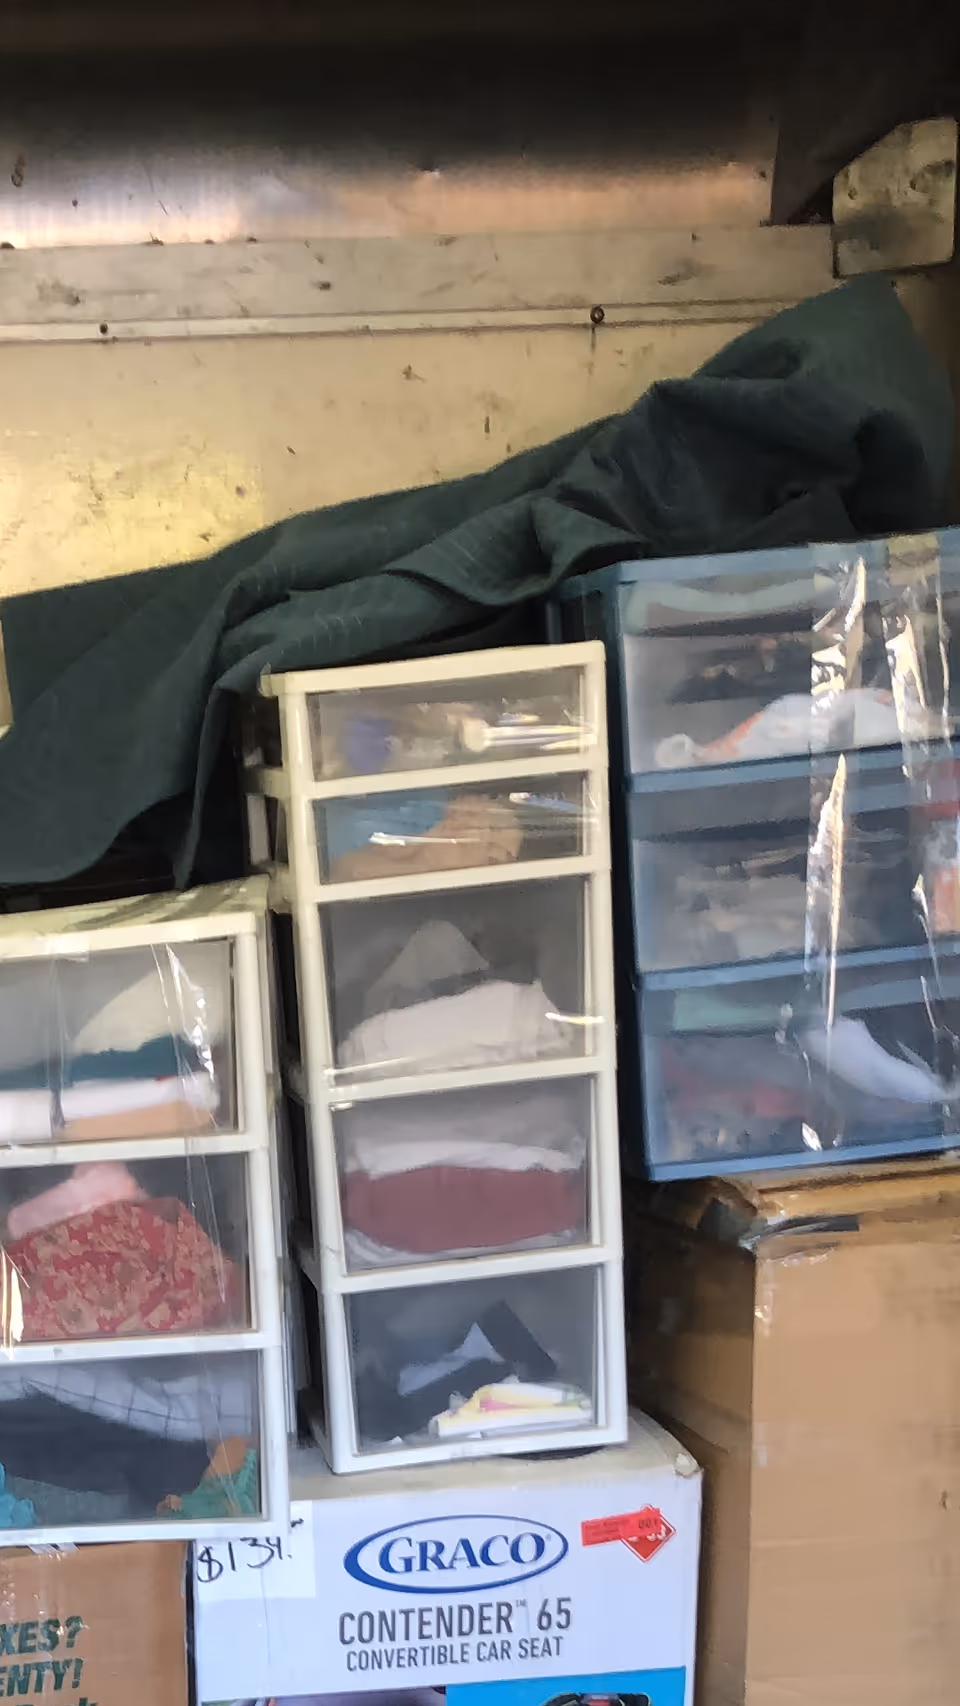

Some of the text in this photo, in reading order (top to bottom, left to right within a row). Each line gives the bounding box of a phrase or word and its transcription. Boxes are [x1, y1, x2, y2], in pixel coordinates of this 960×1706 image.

[378, 1531, 545, 1575] GRACO
[537, 1597, 572, 1631] 65
[346, 1636, 564, 1672] CONVERTIBLE CAR SEAT
